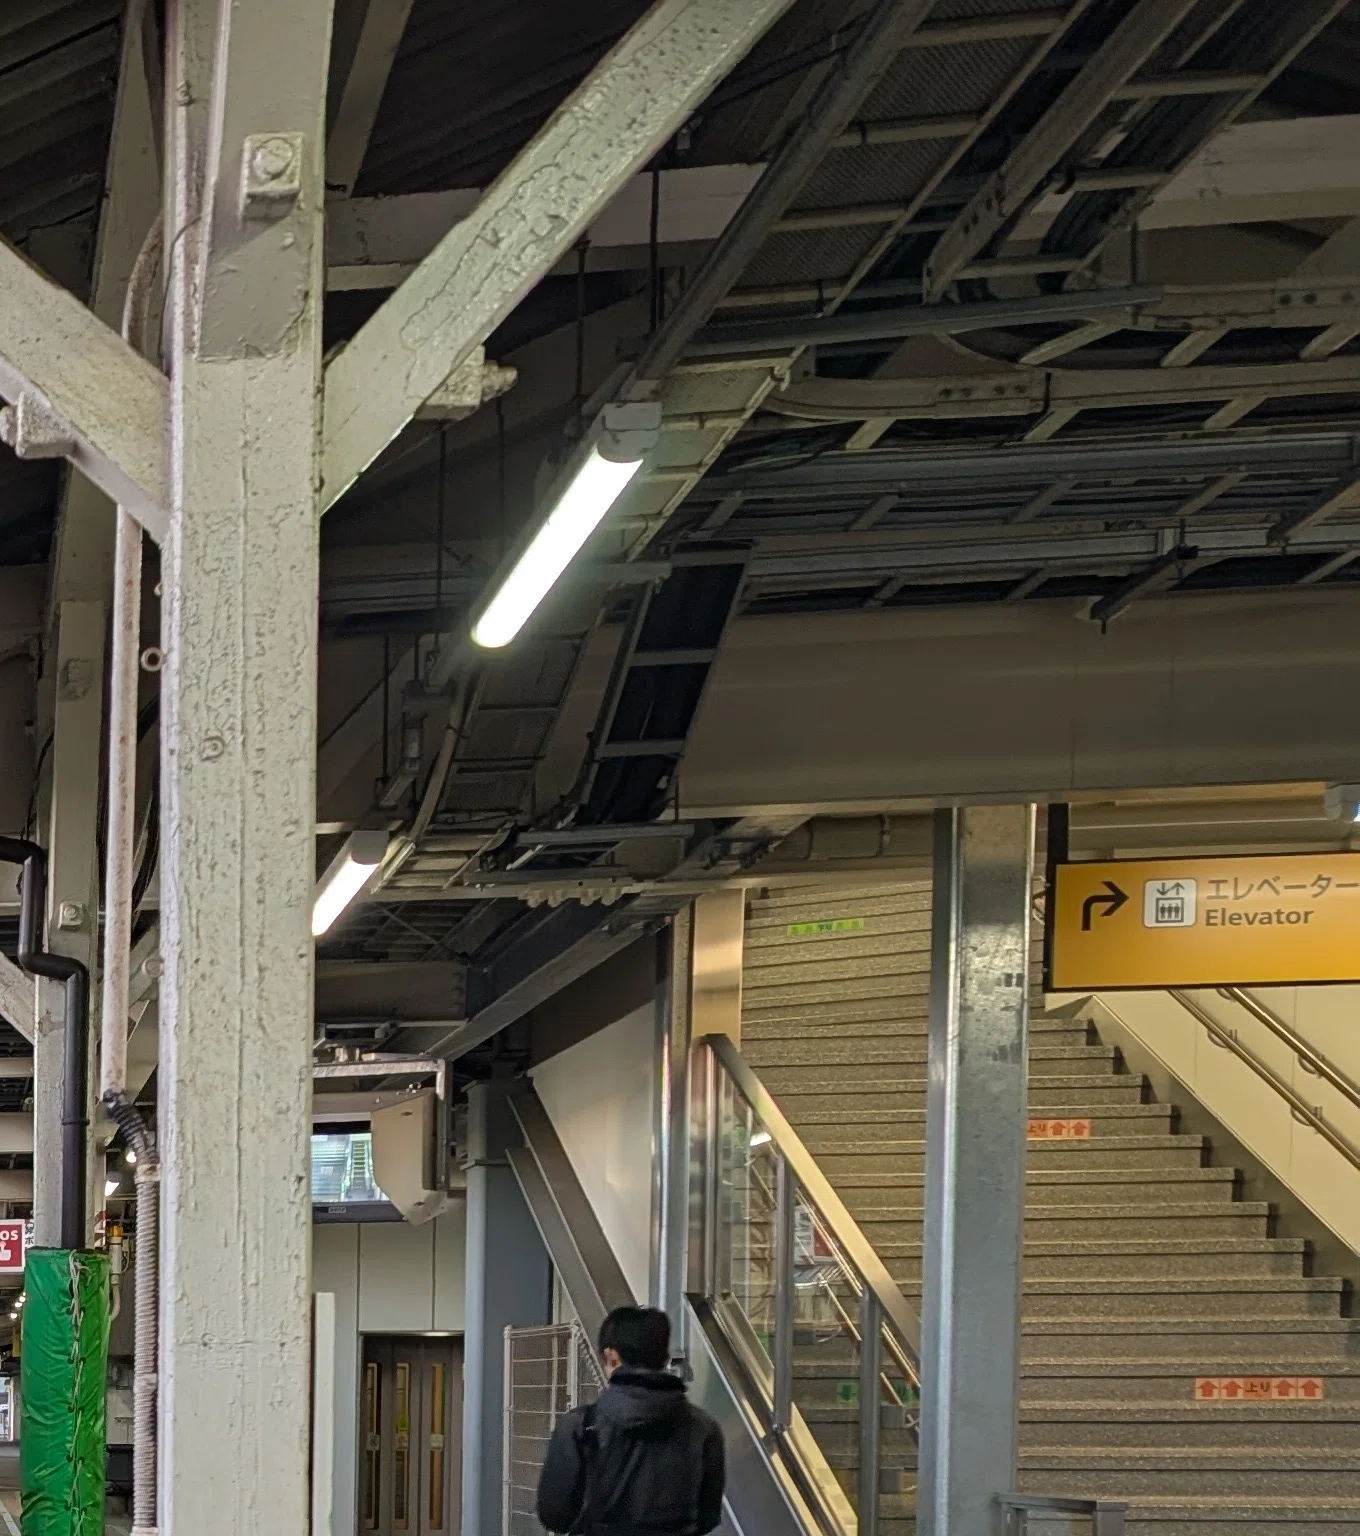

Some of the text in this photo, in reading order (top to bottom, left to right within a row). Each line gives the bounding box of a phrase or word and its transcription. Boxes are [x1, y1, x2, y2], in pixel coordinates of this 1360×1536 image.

[1206, 873, 1360, 900] エレベーター
[1205, 907, 1315, 927] Elevator
[1244, 1381, 1270, 1393] 上り
